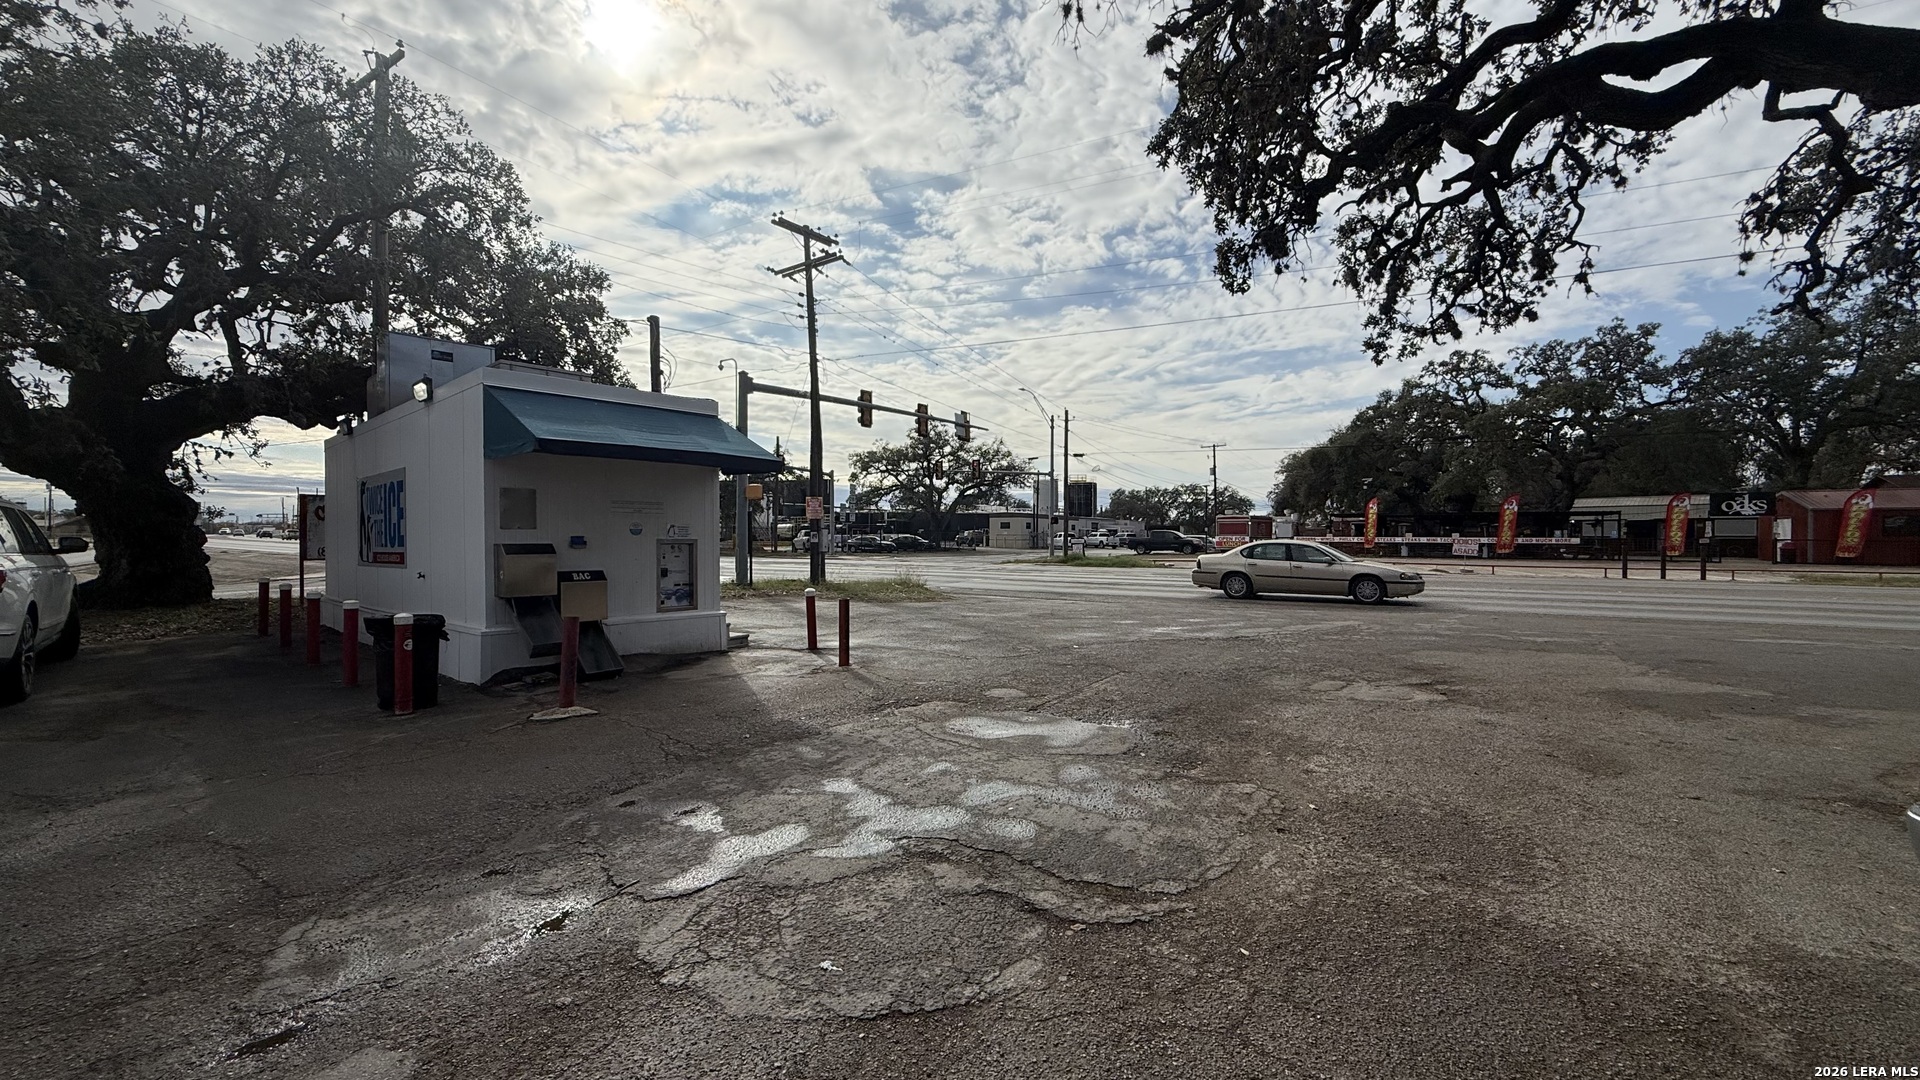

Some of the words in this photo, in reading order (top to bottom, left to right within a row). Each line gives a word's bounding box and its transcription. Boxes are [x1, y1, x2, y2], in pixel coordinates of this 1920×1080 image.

[366, 483, 383, 515] TWICE
[384, 480, 404, 548] ICE
[1721, 494, 1768, 512] oaks
[374, 519, 384, 548] THE
